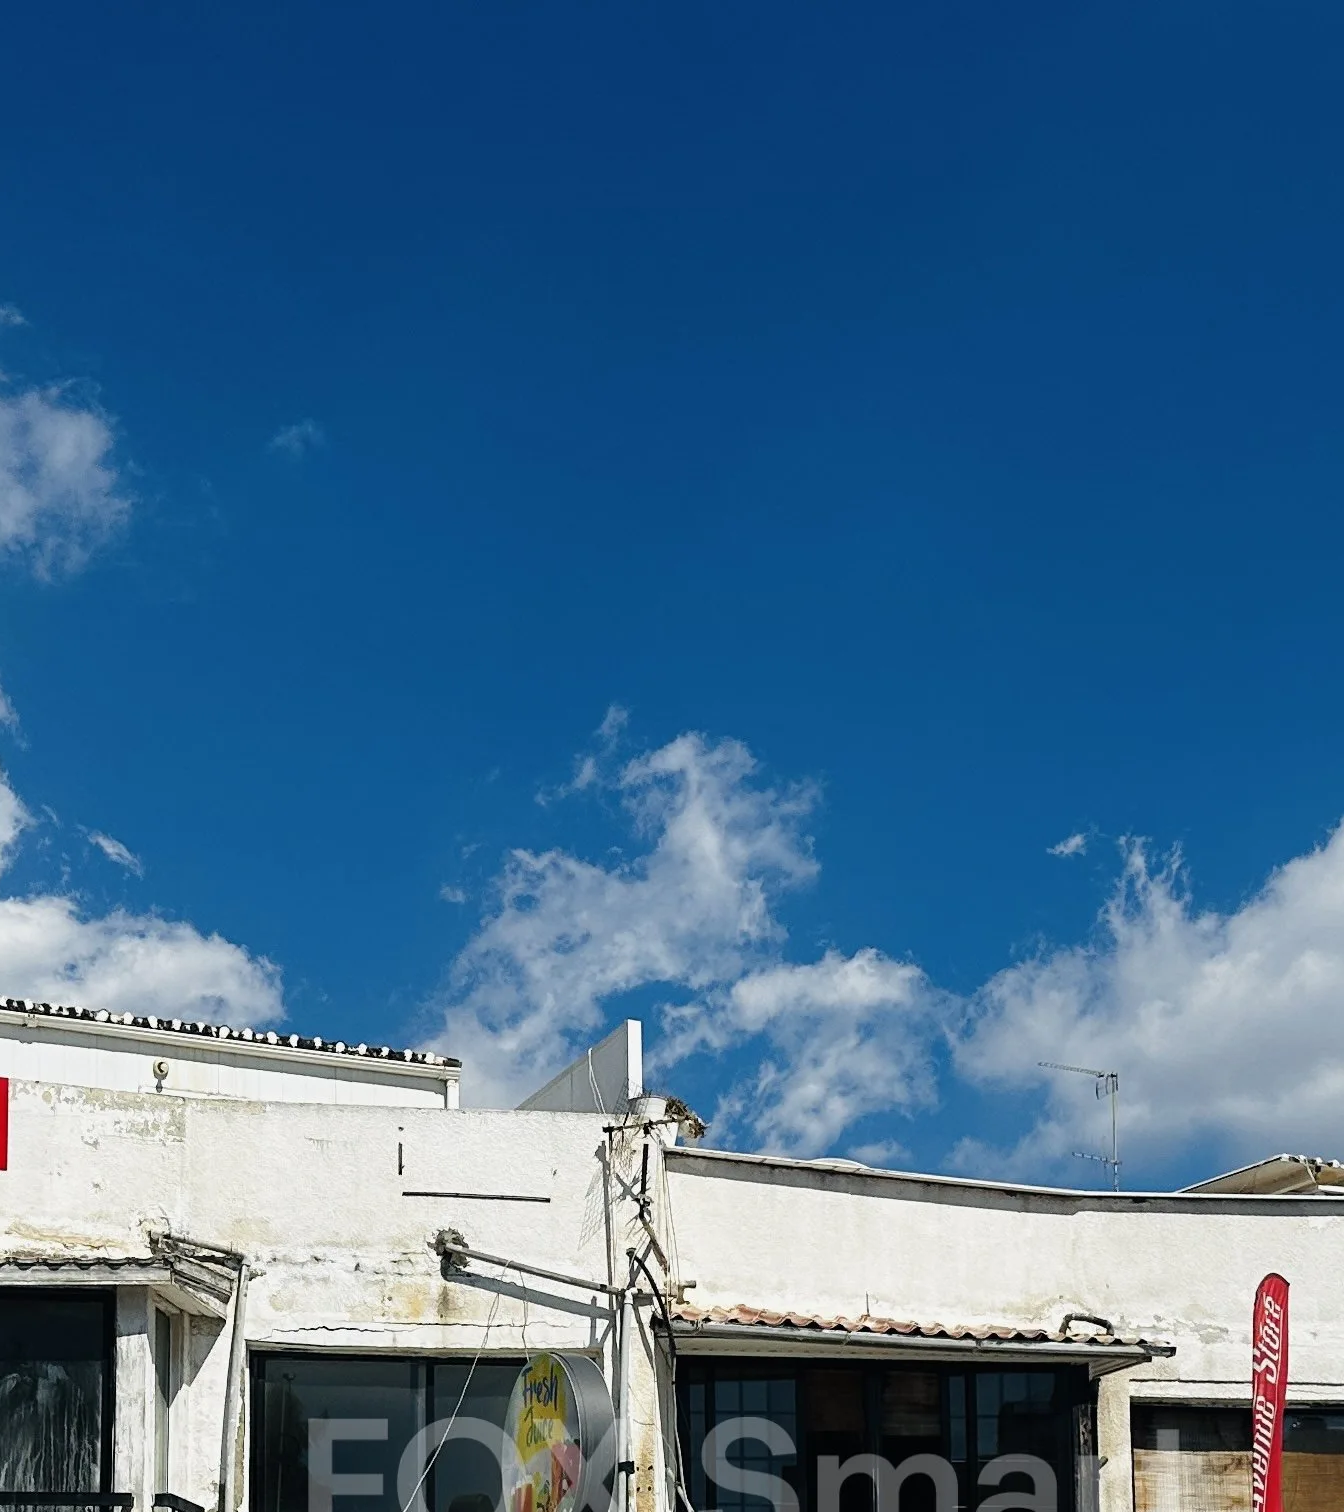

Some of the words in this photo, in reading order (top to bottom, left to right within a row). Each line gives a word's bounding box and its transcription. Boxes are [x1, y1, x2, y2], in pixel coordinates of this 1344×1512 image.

[1253, 1294, 1282, 1385] Store
[522, 1366, 559, 1412] Fresh
[524, 1405, 554, 1448] Juice
